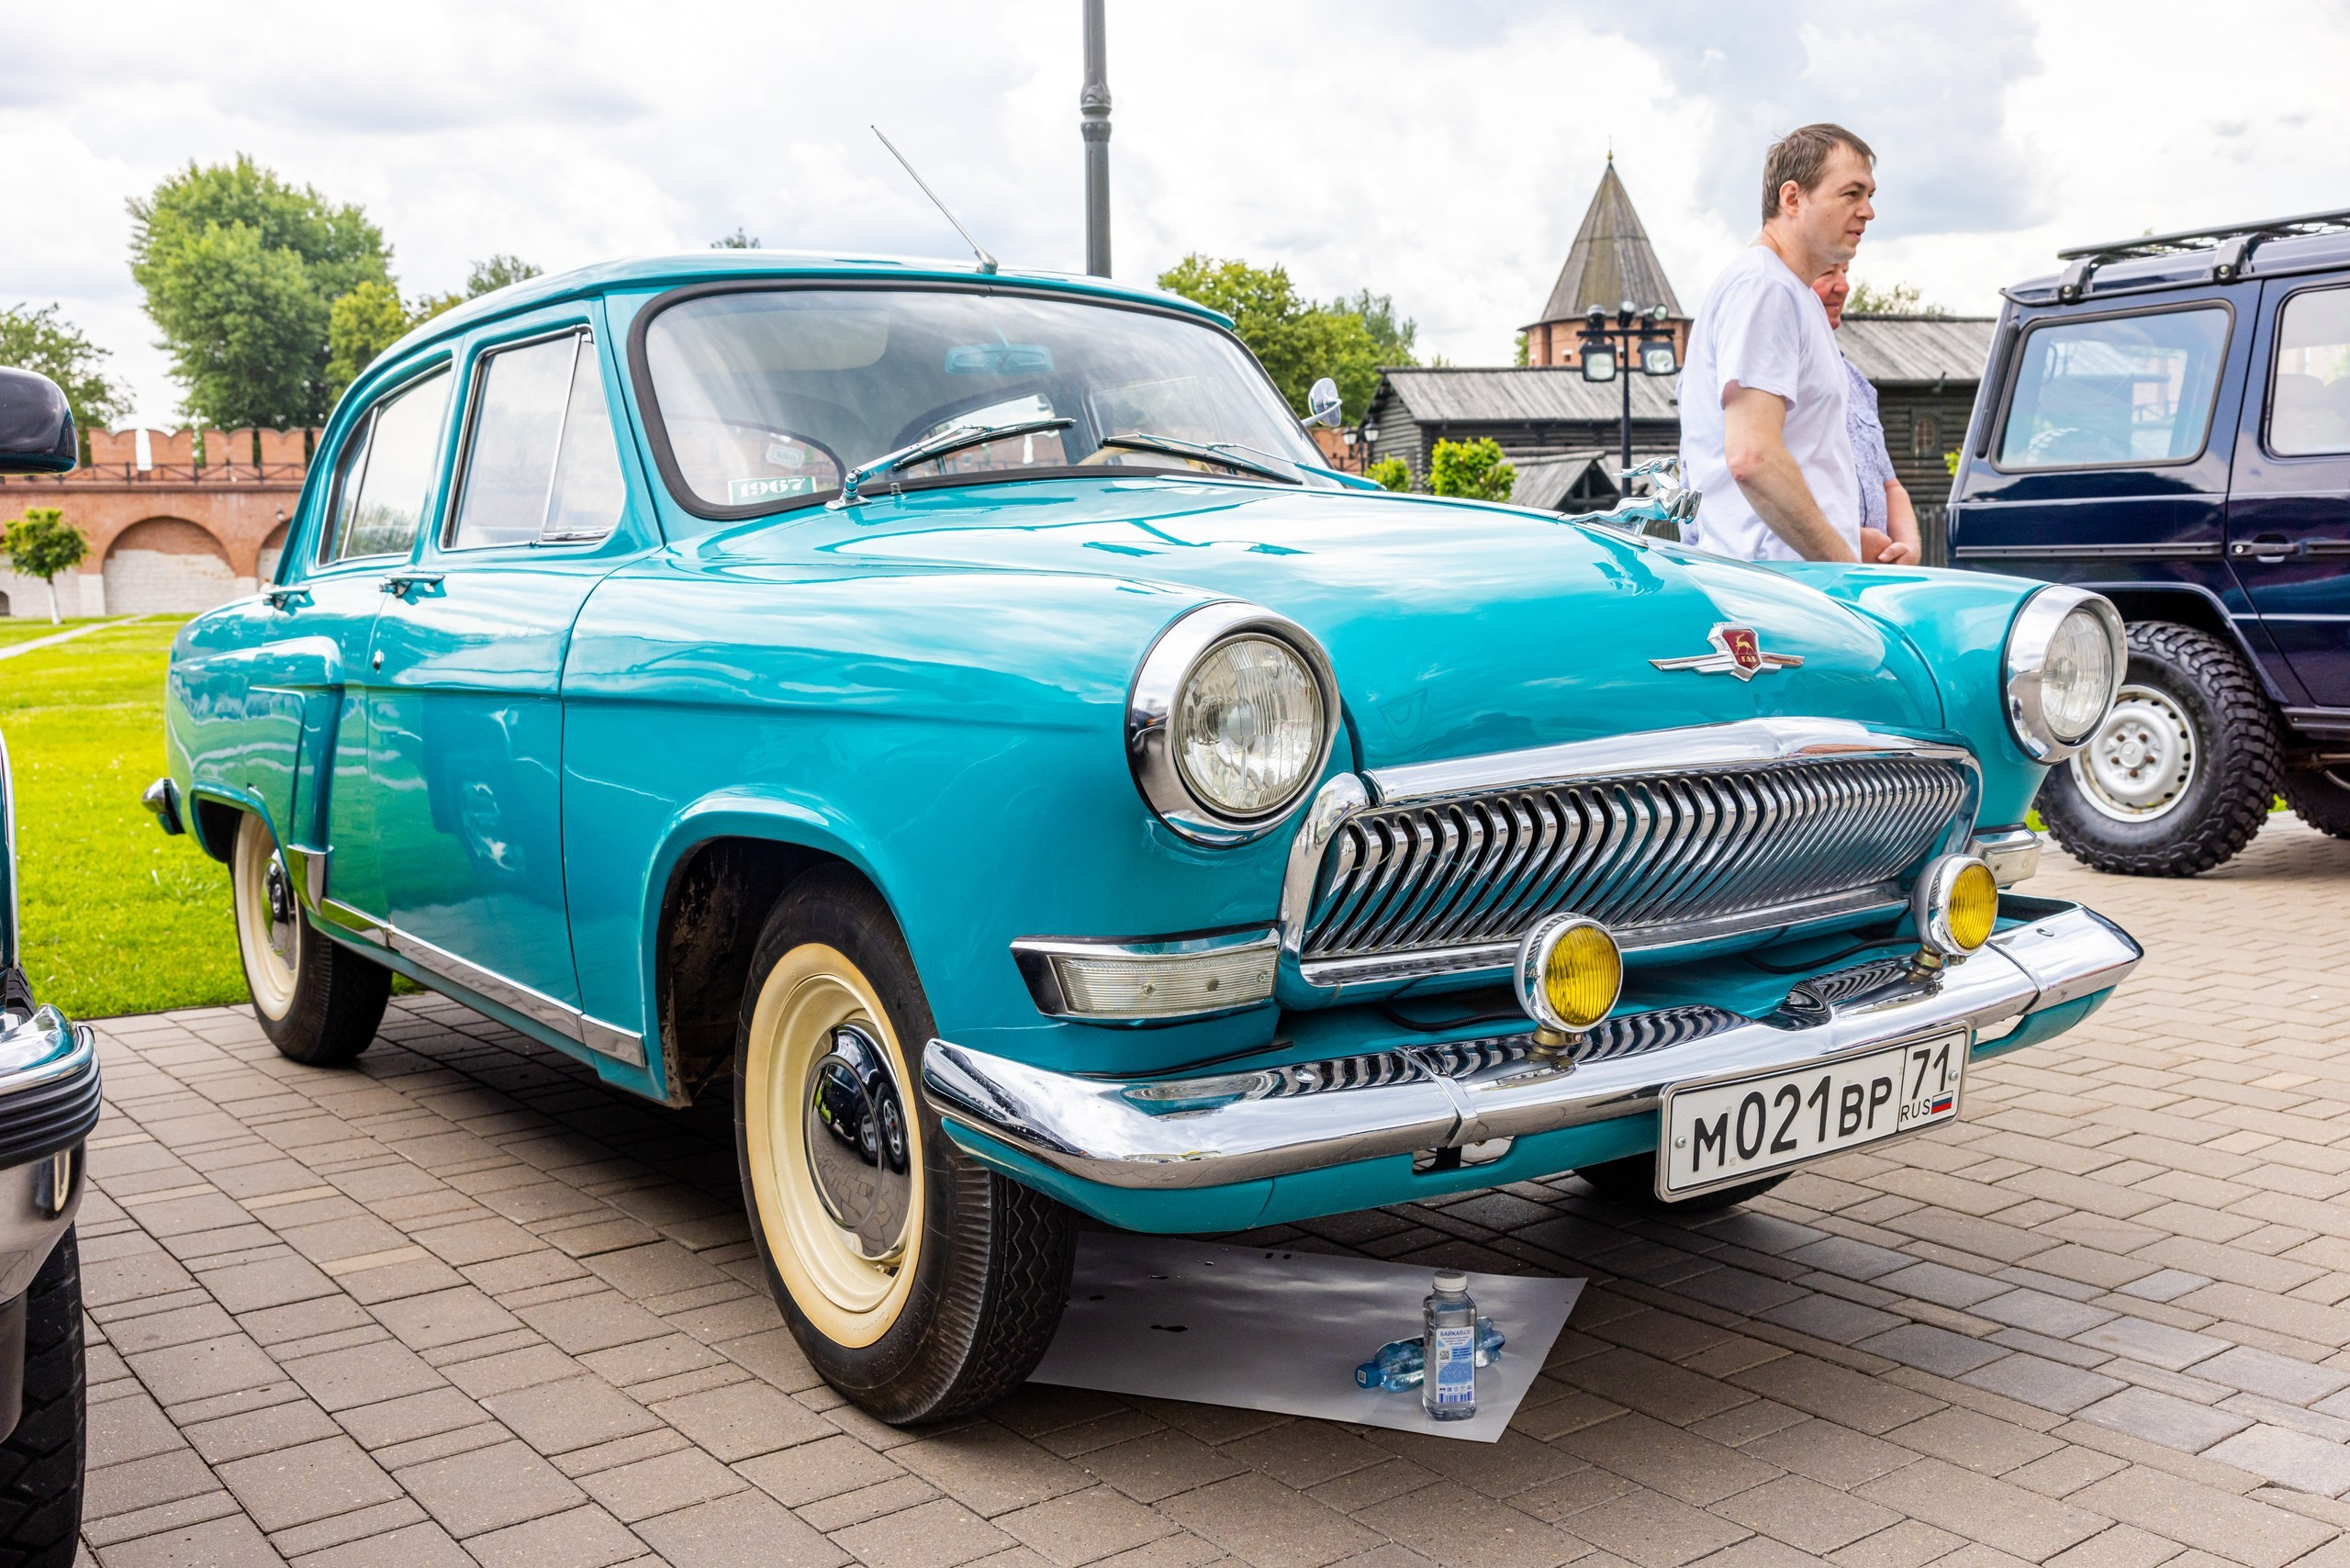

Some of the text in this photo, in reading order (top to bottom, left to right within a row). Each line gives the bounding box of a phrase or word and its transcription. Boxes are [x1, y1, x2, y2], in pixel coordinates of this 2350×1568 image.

[739, 477, 806, 498] 1967
[1692, 1043, 1950, 1172] М021ВР 71
[1900, 1099, 1931, 1123] RUS
